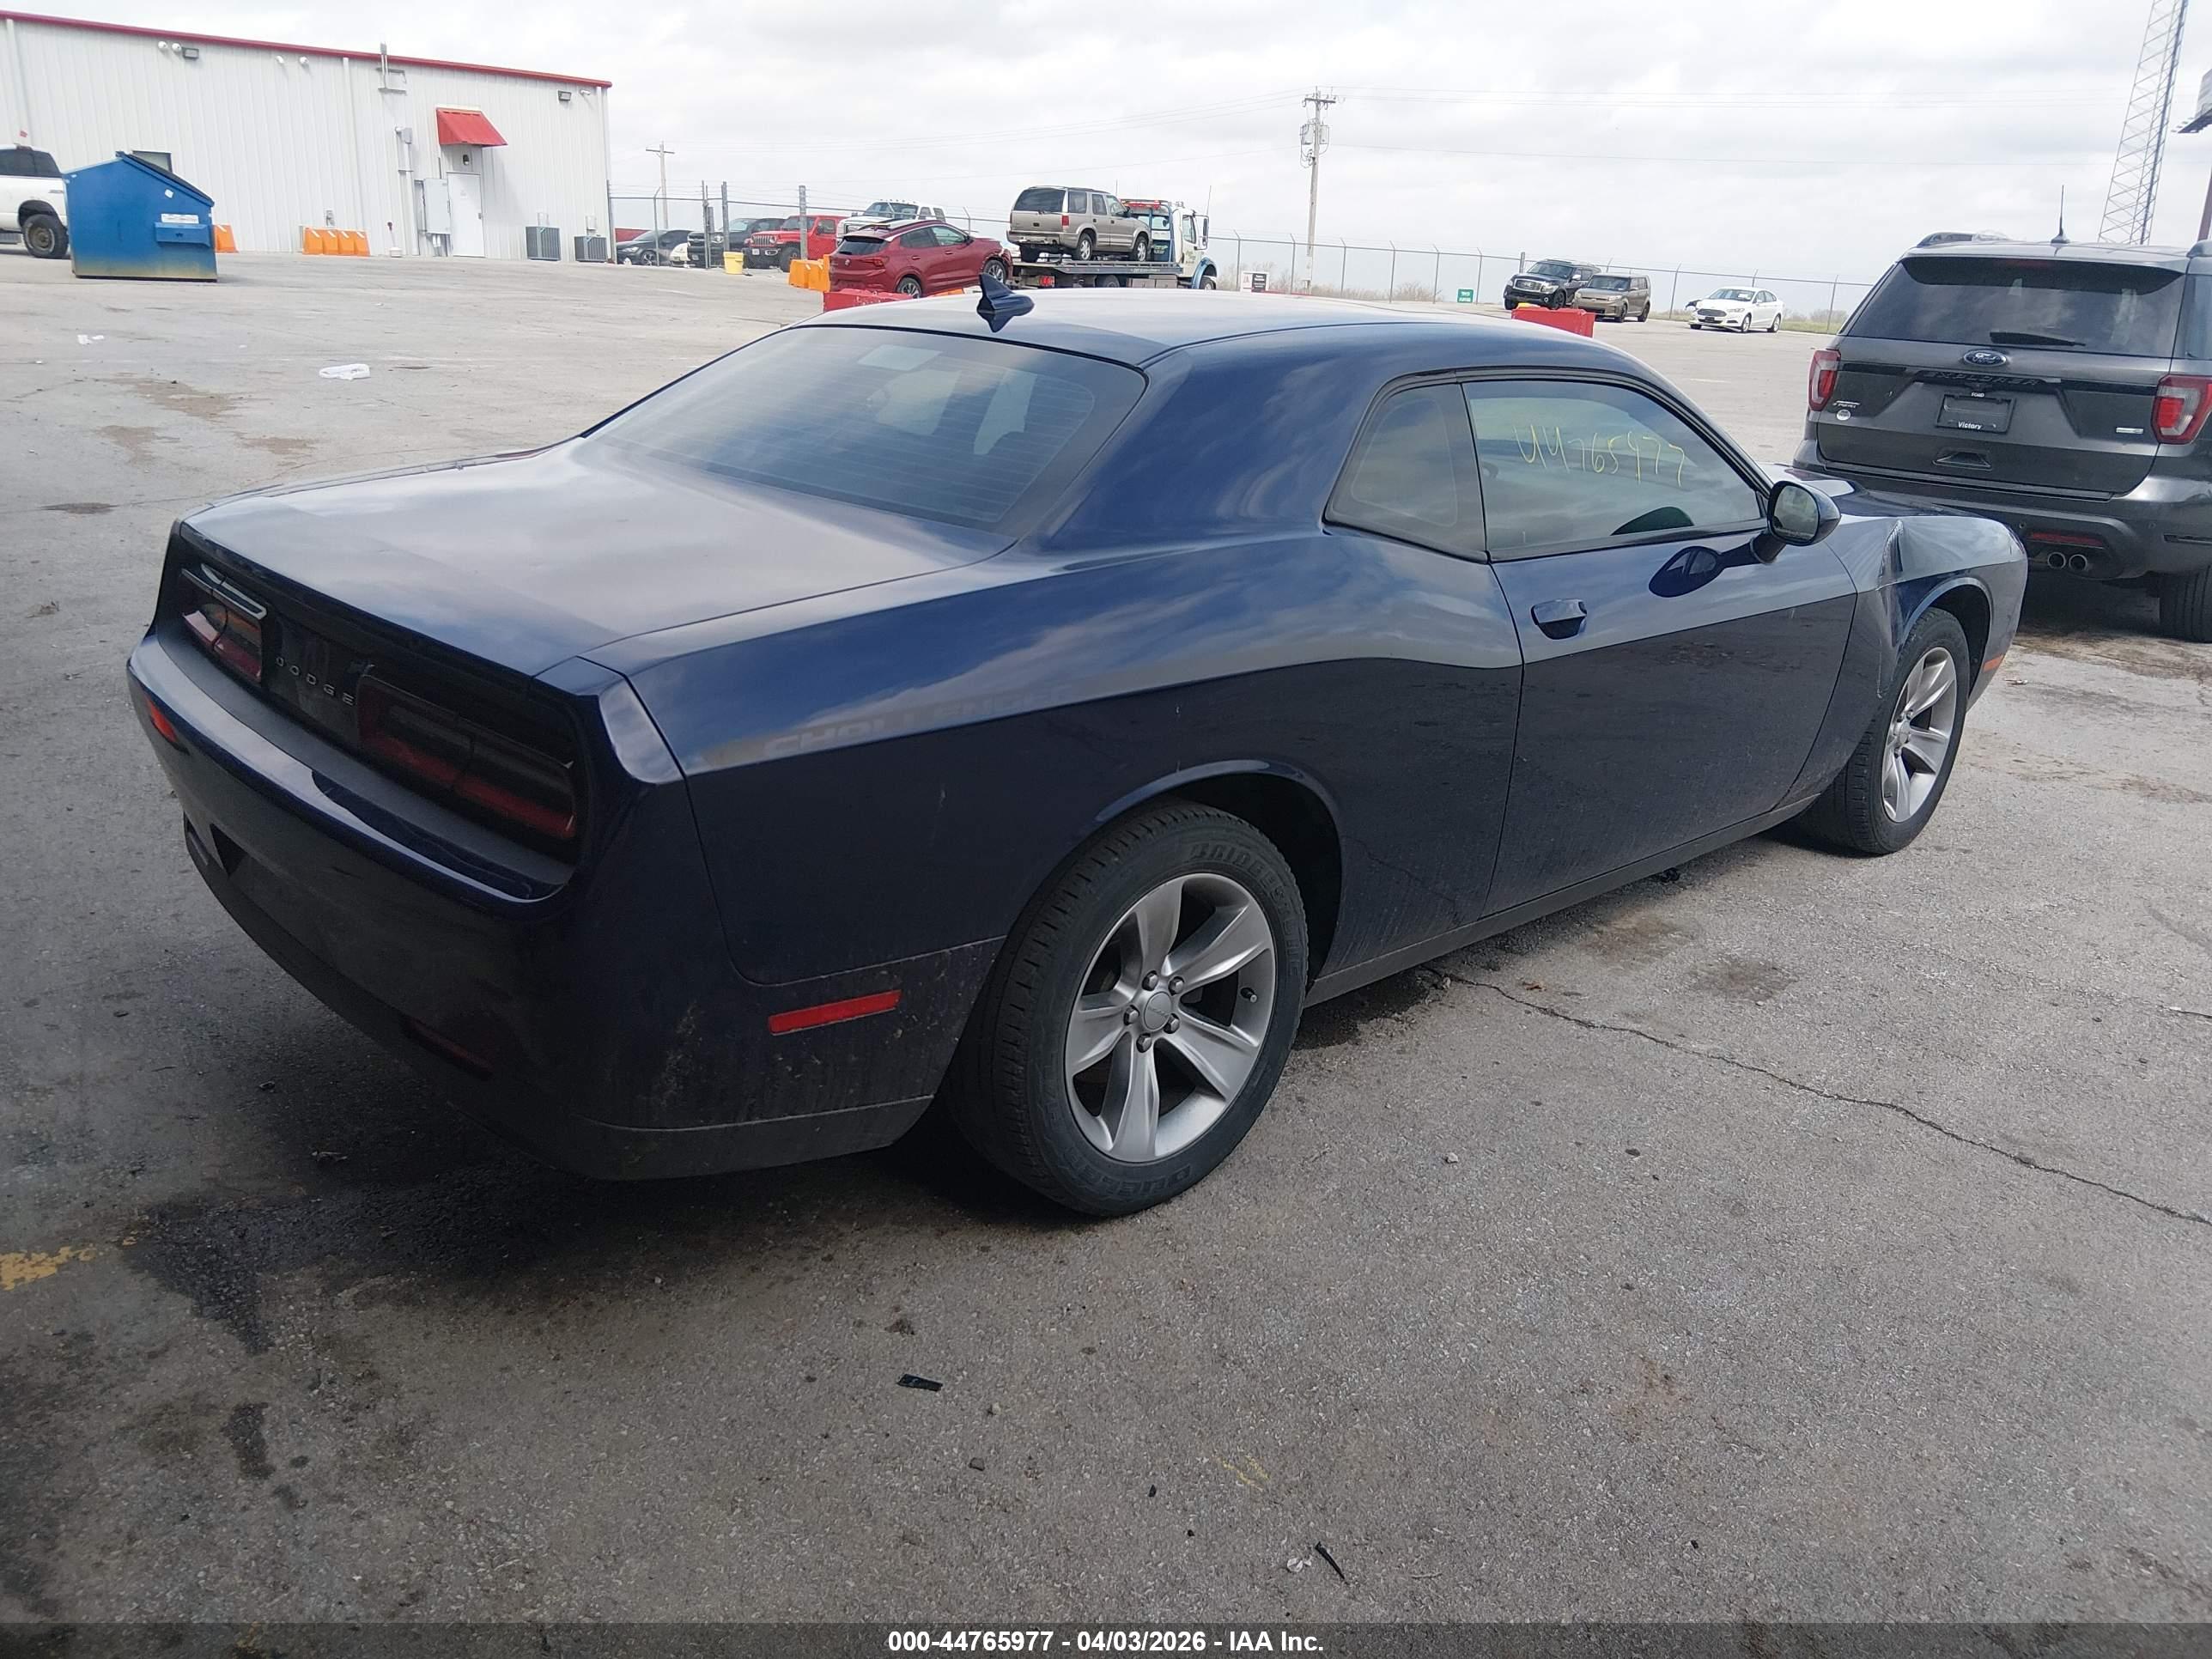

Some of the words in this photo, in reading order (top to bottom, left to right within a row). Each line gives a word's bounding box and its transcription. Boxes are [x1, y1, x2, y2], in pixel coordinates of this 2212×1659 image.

[1921, 371, 2040, 386] EXPLORER
[1958, 421, 1983, 430] Victory
[276, 656, 355, 706] DODGE
